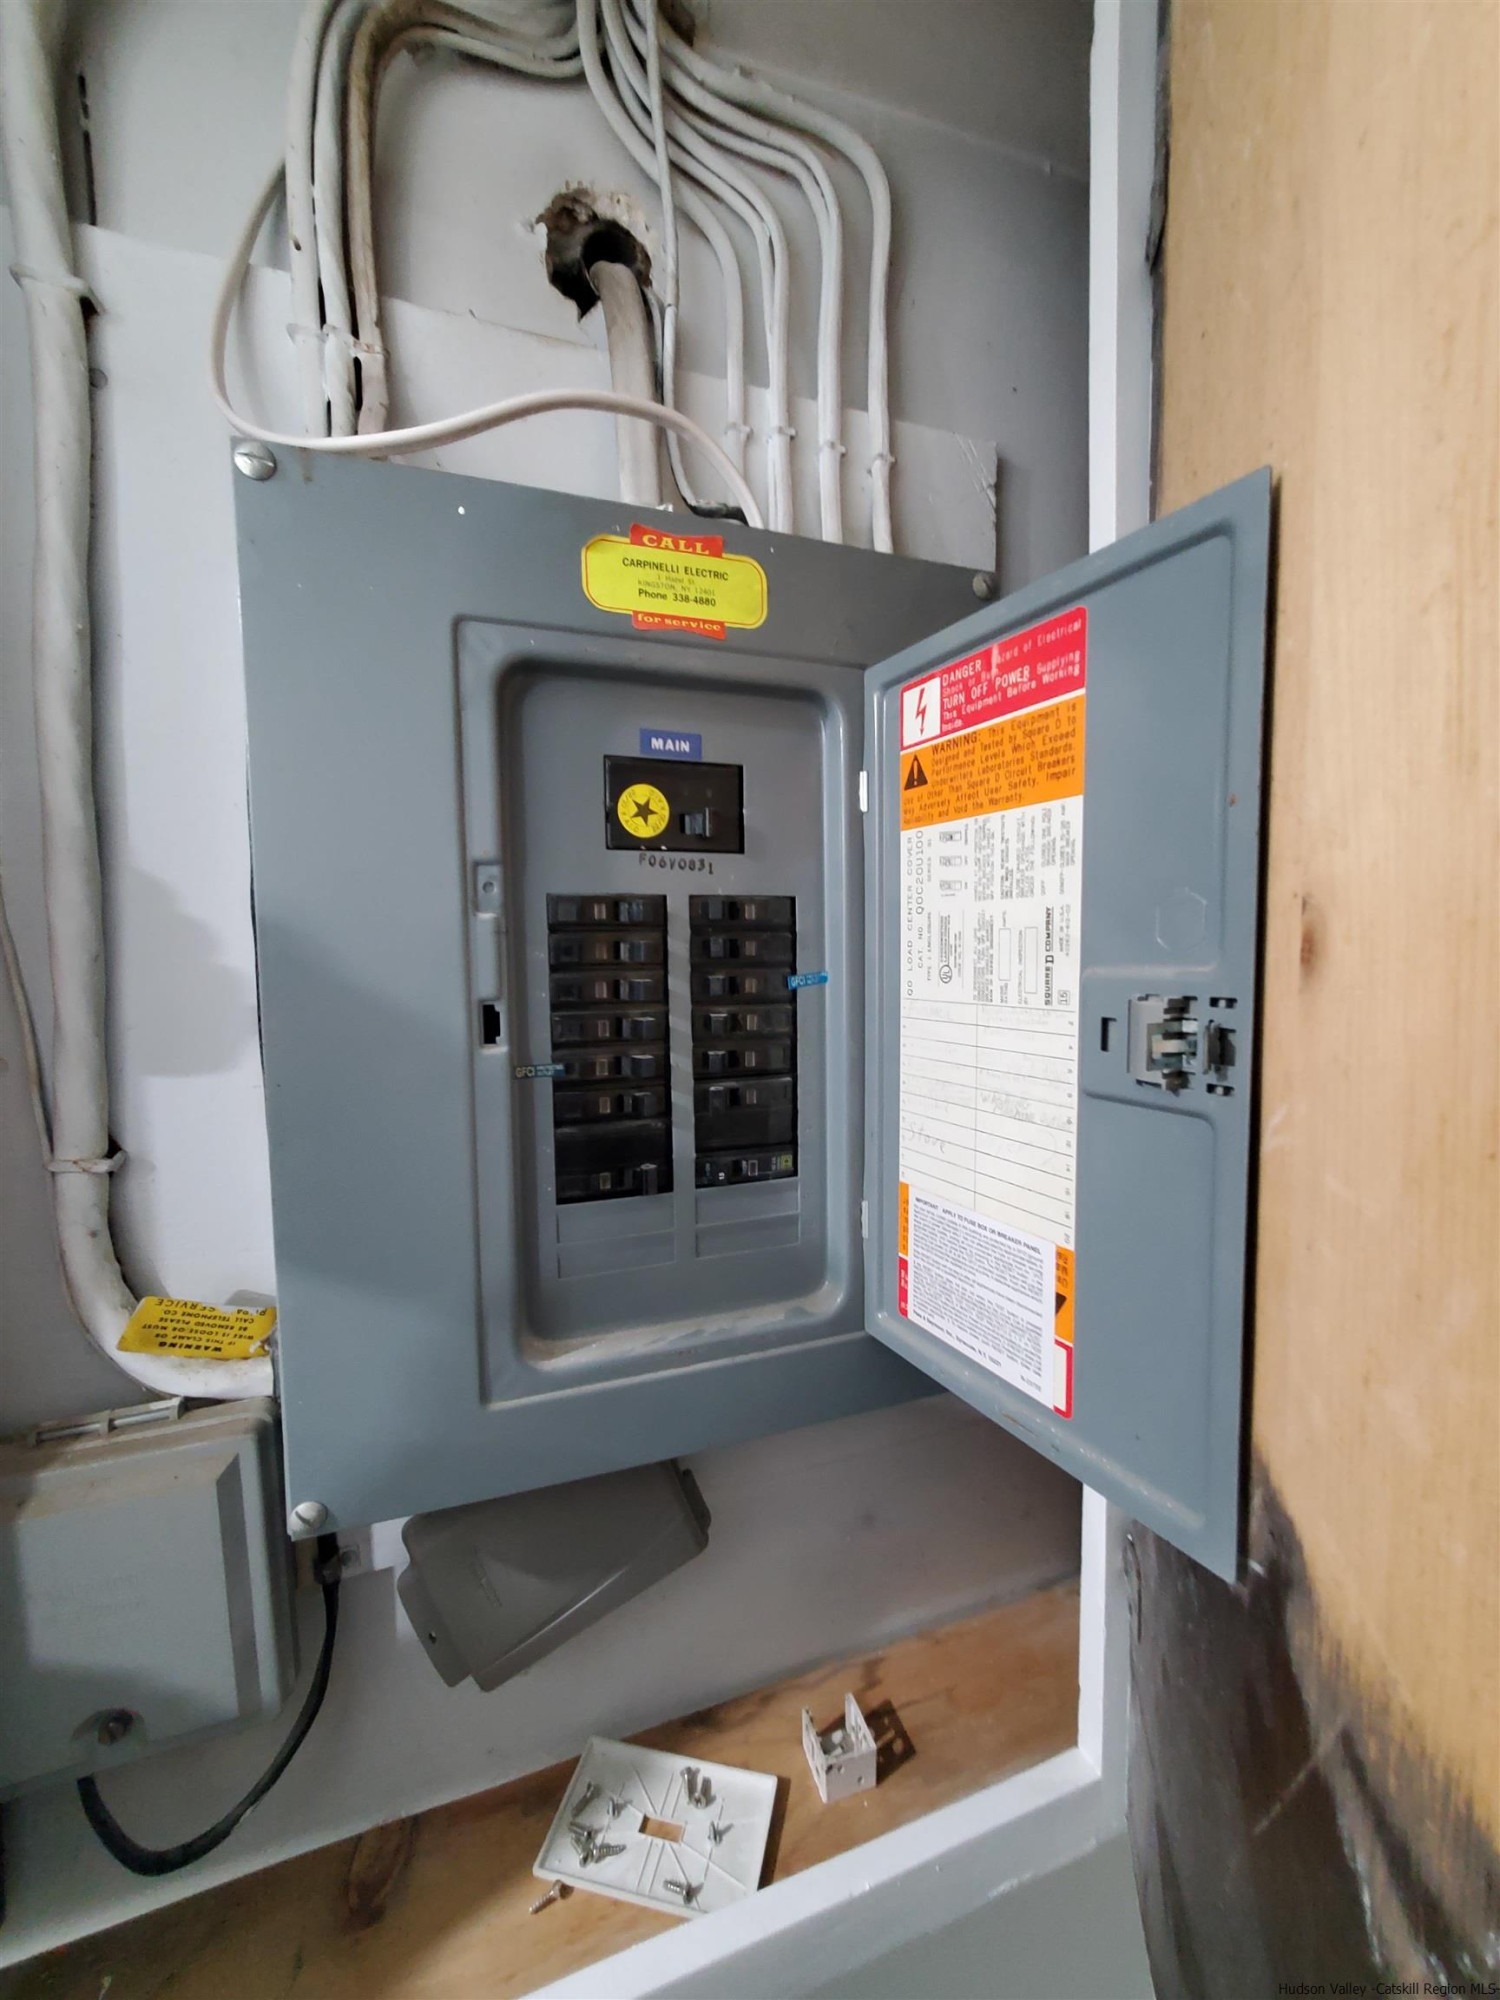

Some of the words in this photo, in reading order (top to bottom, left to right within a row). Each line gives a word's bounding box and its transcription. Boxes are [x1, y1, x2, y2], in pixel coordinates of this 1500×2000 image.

[642, 534, 710, 555] CALL
[622, 557, 680, 574] CARPINELLI
[684, 566, 729, 581] ELECTRIC
[638, 588, 668, 601] Phone
[672, 593, 717, 607] 338-4880
[637, 613, 662, 623] for
[664, 617, 721, 631] service
[942, 660, 982, 687] DANGER
[1023, 640, 1032, 653] of
[1037, 619, 1082, 648] Electrical
[942, 692, 966, 711] TURN
[971, 682, 989, 701] OFF
[995, 665, 1031, 691] POWER
[1036, 650, 1081, 676] Supplying
[942, 681, 964, 698] Shock
[968, 678, 976, 688] or
[942, 709, 958, 721] This
[961, 691, 1002, 715] Equipment
[1006, 680, 1037, 698] Before
[1041, 664, 1080, 686] Working
[931, 731, 981, 756] WARNING:
[988, 726, 1005, 738] This
[1010, 707, 1060, 731] Equipment
[1067, 702, 1077, 713] is
[963, 746, 976, 758] and
[980, 738, 1004, 752] Tested
[1022, 723, 1049, 740] Square
[1055, 718, 1062, 730] D
[1067, 715, 1077, 727] to
[651, 737, 690, 753] MAIN
[1011, 739, 1036, 756] Which
[1042, 728, 1077, 746] Exceed
[1004, 765, 1032, 781] Circuit
[1037, 754, 1075, 772] Breakers
[956, 789, 980, 803] Affect
[984, 785, 1002, 797] User
[1046, 767, 1076, 782] Impair
[1045, 955, 1054, 964] D
[790, 975, 806, 988] GFCI
[516, 1066, 536, 1078] GFCI
[978, 1222, 988, 1232] BOX
[159, 1316, 191, 1325] PLEASE
[180, 1311, 231, 1322] TELEPHONE
[235, 1316, 255, 1324] CALL
[142, 1322, 168, 1331] MUST
[189, 1327, 219, 1337] LOOSE
[194, 1320, 234, 1331] REMOVED
[172, 1333, 202, 1343] CLAMP
[206, 1337, 223, 1345] THIS
[158, 1341, 222, 1352] WARNING
